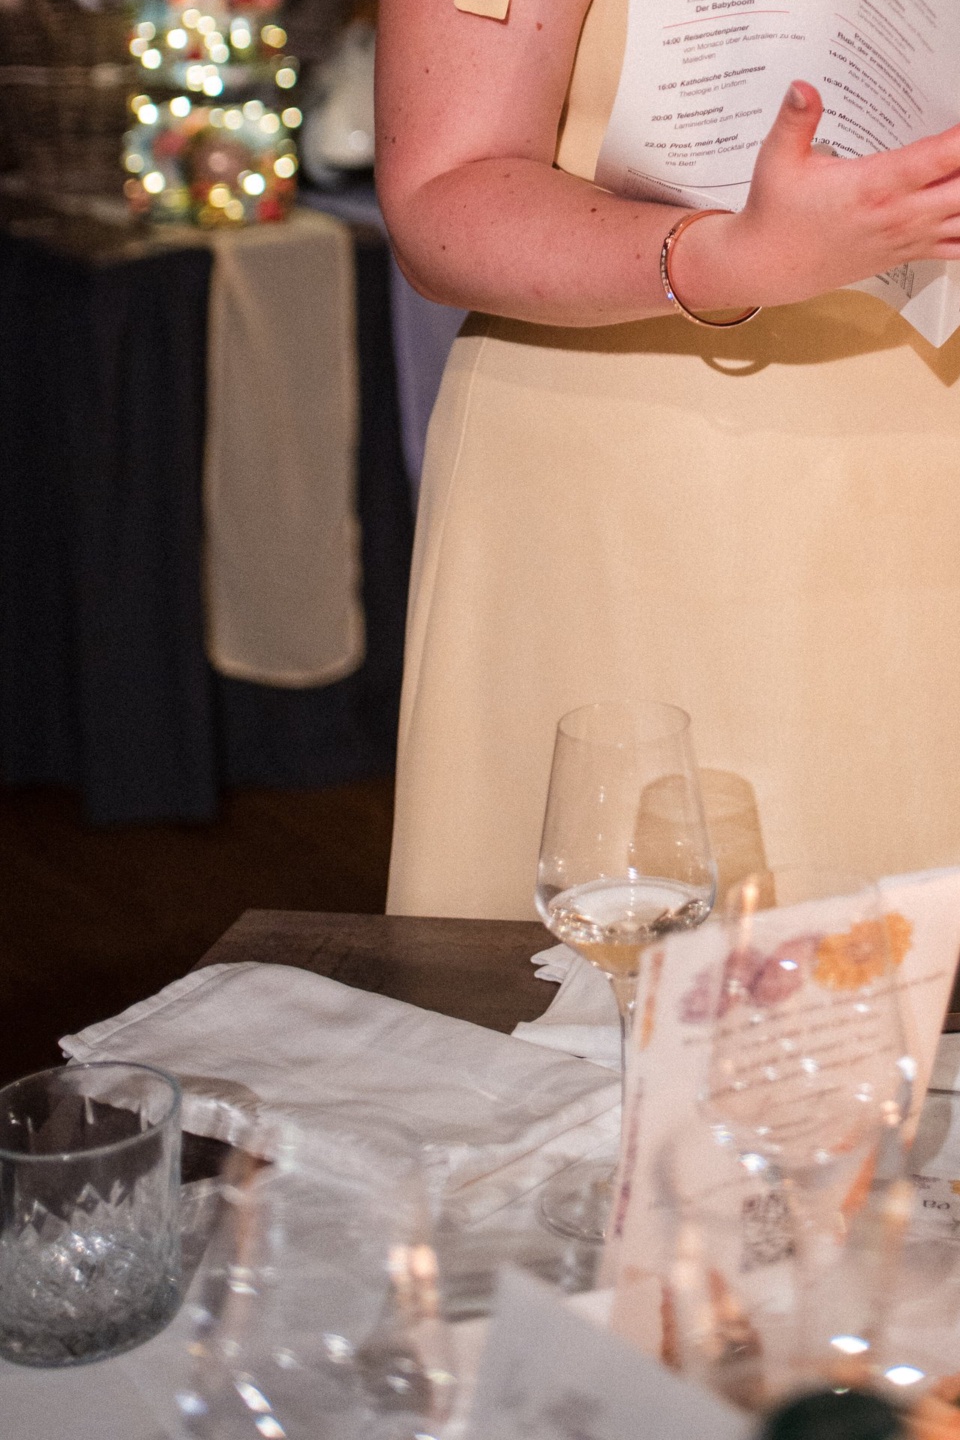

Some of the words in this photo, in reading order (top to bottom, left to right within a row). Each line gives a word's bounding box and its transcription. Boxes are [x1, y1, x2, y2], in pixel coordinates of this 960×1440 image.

[695, 4, 709, 13] Der
[684, 24, 750, 42] Reiseroutenplaner
[697, 39, 724, 51] Monaco
[742, 33, 778, 42] Australien
[828, 49, 847, 63] 14:00
[849, 60, 860, 72] Wie
[657, 82, 678, 91] 16:00
[680, 73, 722, 88] Katholische
[723, 64, 766, 79] Schulmesse
[679, 86, 712, 98] Theologie
[721, 79, 747, 90] Uniform
[823, 75, 843, 88] 16:30
[843, 85, 868, 105] Backen
[651, 114, 673, 122] 20:00
[676, 105, 724, 120] Teleshopping
[674, 117, 718, 130] Laminierfolie
[719, 115, 734, 123] zum
[735, 107, 763, 120] Kilopreis
[667, 150, 688, 158] Ohne
[690, 149, 716, 157] meinen
[718, 142, 745, 154] Cocktail
[746, 139, 759, 150] geh
[669, 141, 693, 150] Prost,
[695, 139, 713, 147] mein
[715, 134, 739, 145] Aperol
